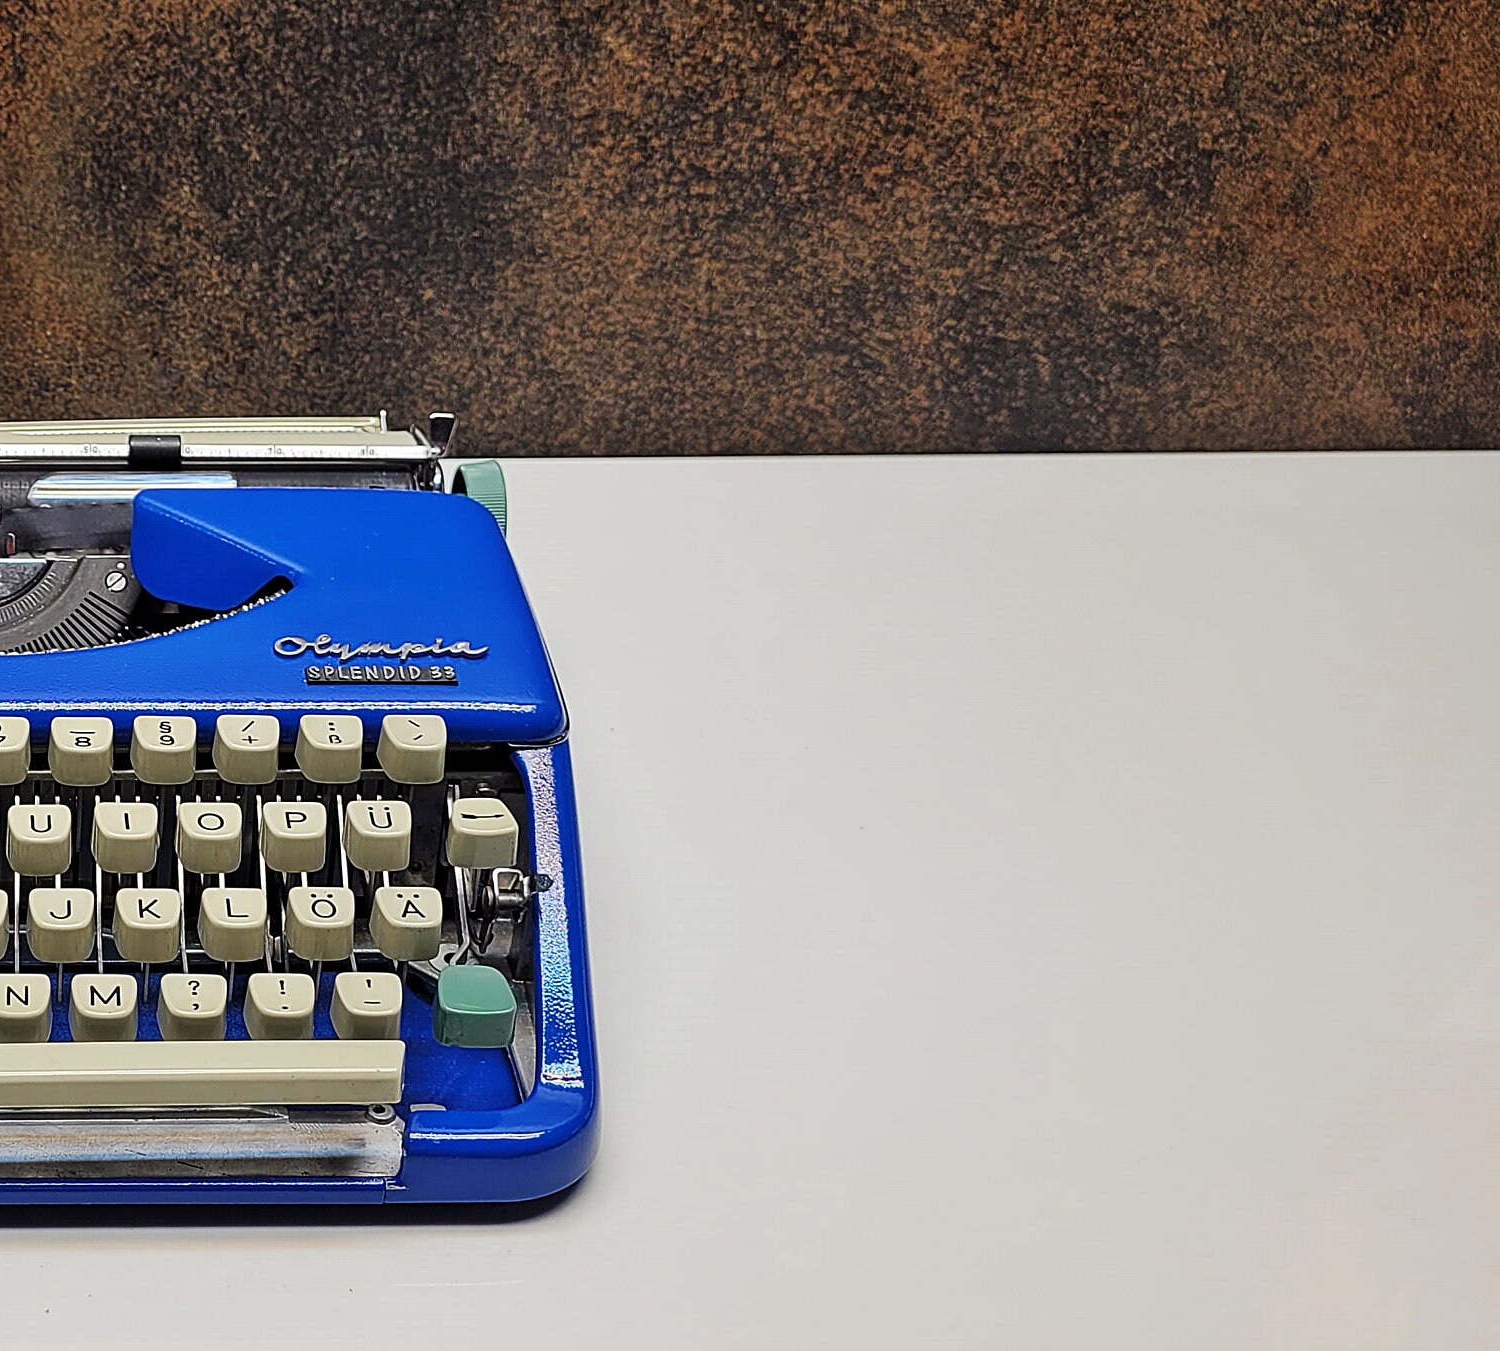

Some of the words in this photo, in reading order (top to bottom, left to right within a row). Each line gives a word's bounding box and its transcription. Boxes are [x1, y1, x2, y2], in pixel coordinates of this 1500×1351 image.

[274, 634, 489, 662] Olympia
[307, 666, 422, 681] SPLENDID
[430, 666, 456, 680] 33
[74, 736, 92, 748] 8
[159, 734, 175, 746] 9
[159, 721, 172, 734] §
[30, 814, 52, 833] U
[123, 812, 131, 830] I
[197, 812, 225, 831] O
[284, 811, 308, 829] P
[367, 806, 393, 829] Ü
[49, 899, 72, 920] J
[138, 898, 161, 919] K
[225, 898, 249, 918] L
[310, 893, 337, 919] Ö
[396, 893, 426, 919] Ä
[6, 985, 29, 1006] N
[89, 985, 122, 1007] M
[187, 980, 200, 996] ?
[279, 979, 286, 995] !
